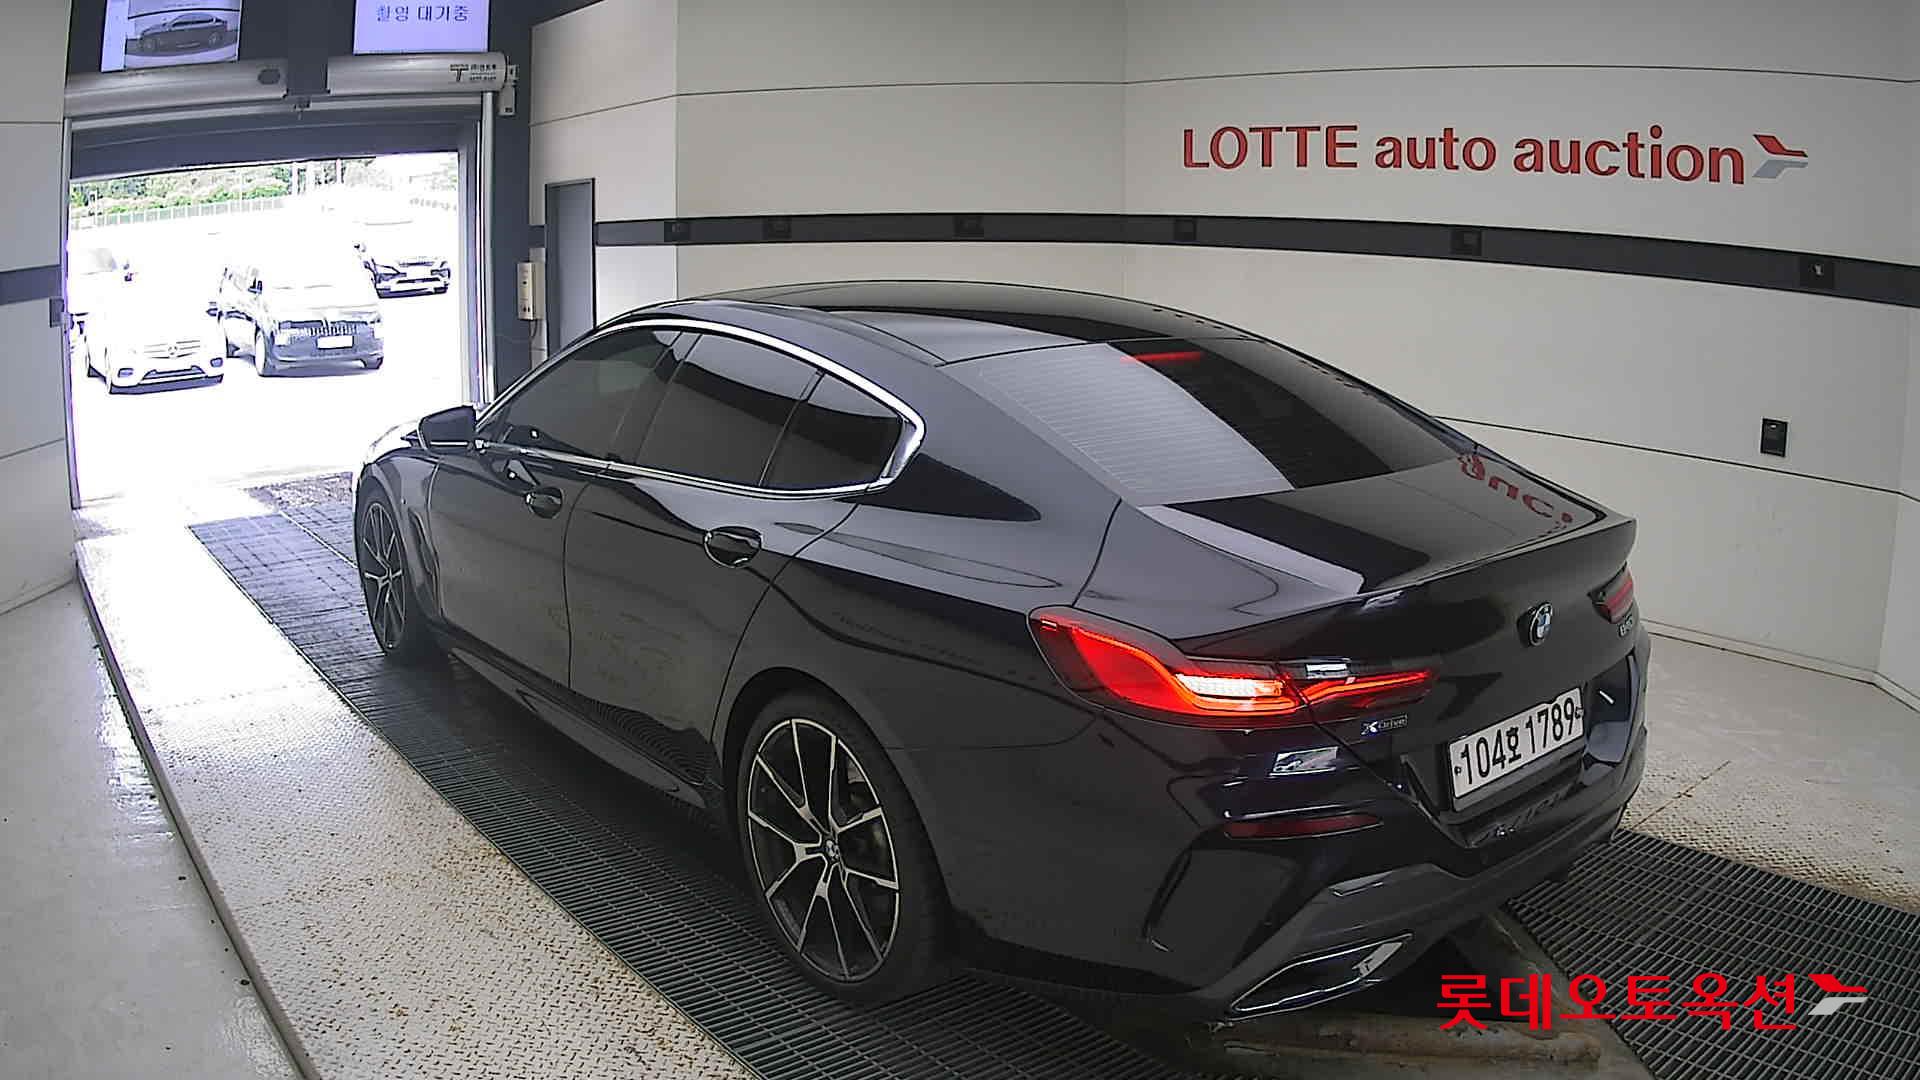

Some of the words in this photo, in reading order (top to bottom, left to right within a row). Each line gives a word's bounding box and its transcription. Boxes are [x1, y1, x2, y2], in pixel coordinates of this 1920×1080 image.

[417, 5, 471, 22] 대기중
[1183, 125, 1358, 169] LOTTE
[1375, 128, 1497, 172] auto
[1514, 125, 1745, 184] auction
[1526, 697, 1575, 754] 1789
